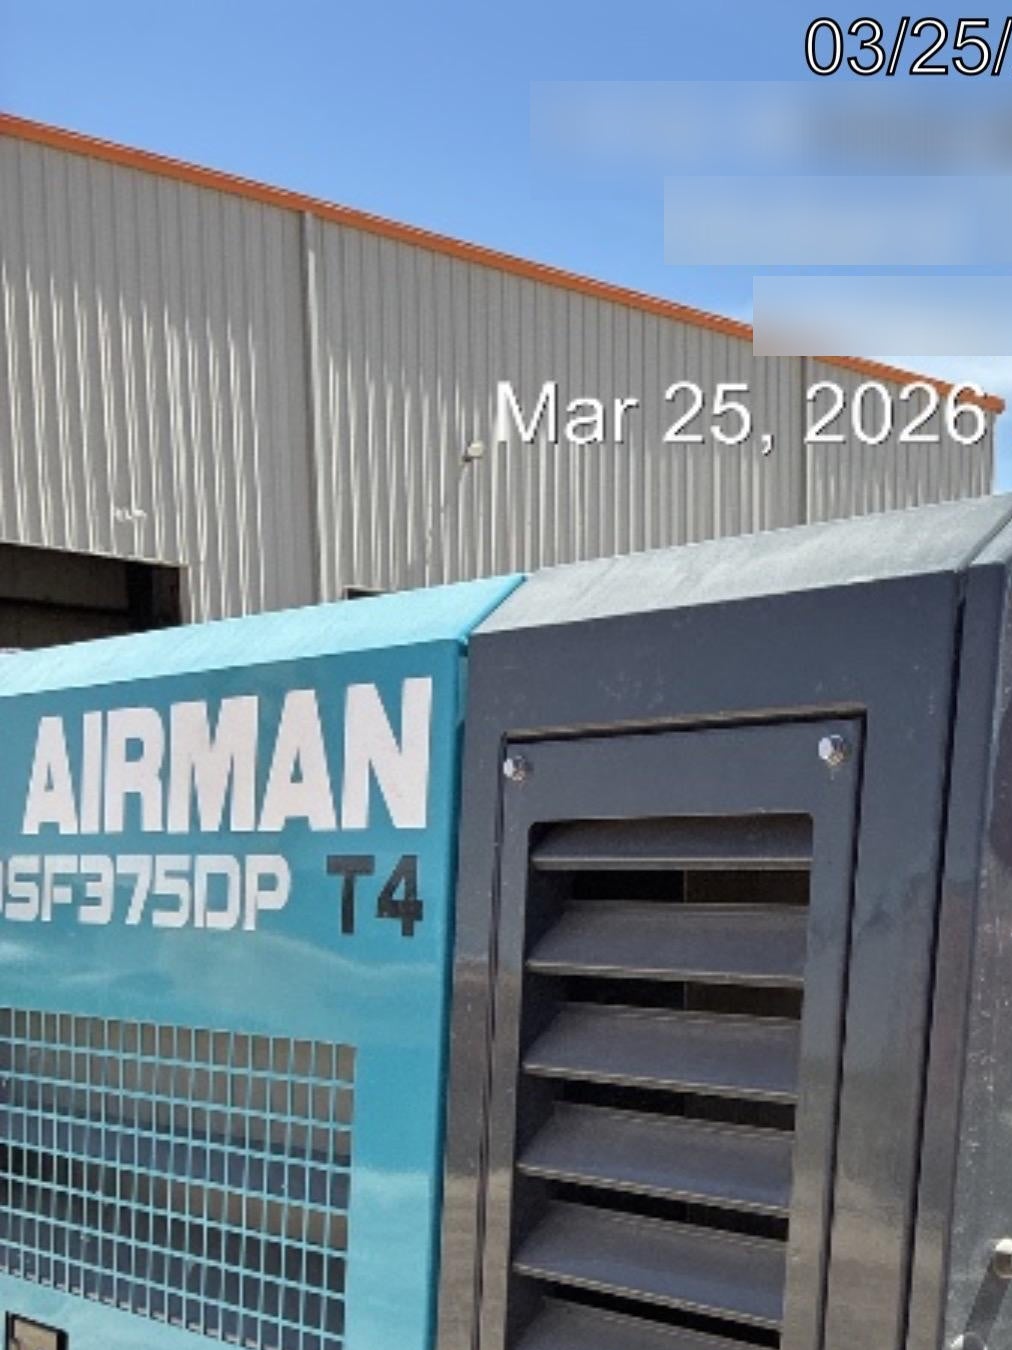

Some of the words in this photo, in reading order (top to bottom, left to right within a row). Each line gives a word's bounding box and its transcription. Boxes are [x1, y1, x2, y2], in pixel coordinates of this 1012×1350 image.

[22, 677, 432, 834] AIRMAN
[0, 854, 291, 931] SF375DP
[326, 854, 423, 937] T4
